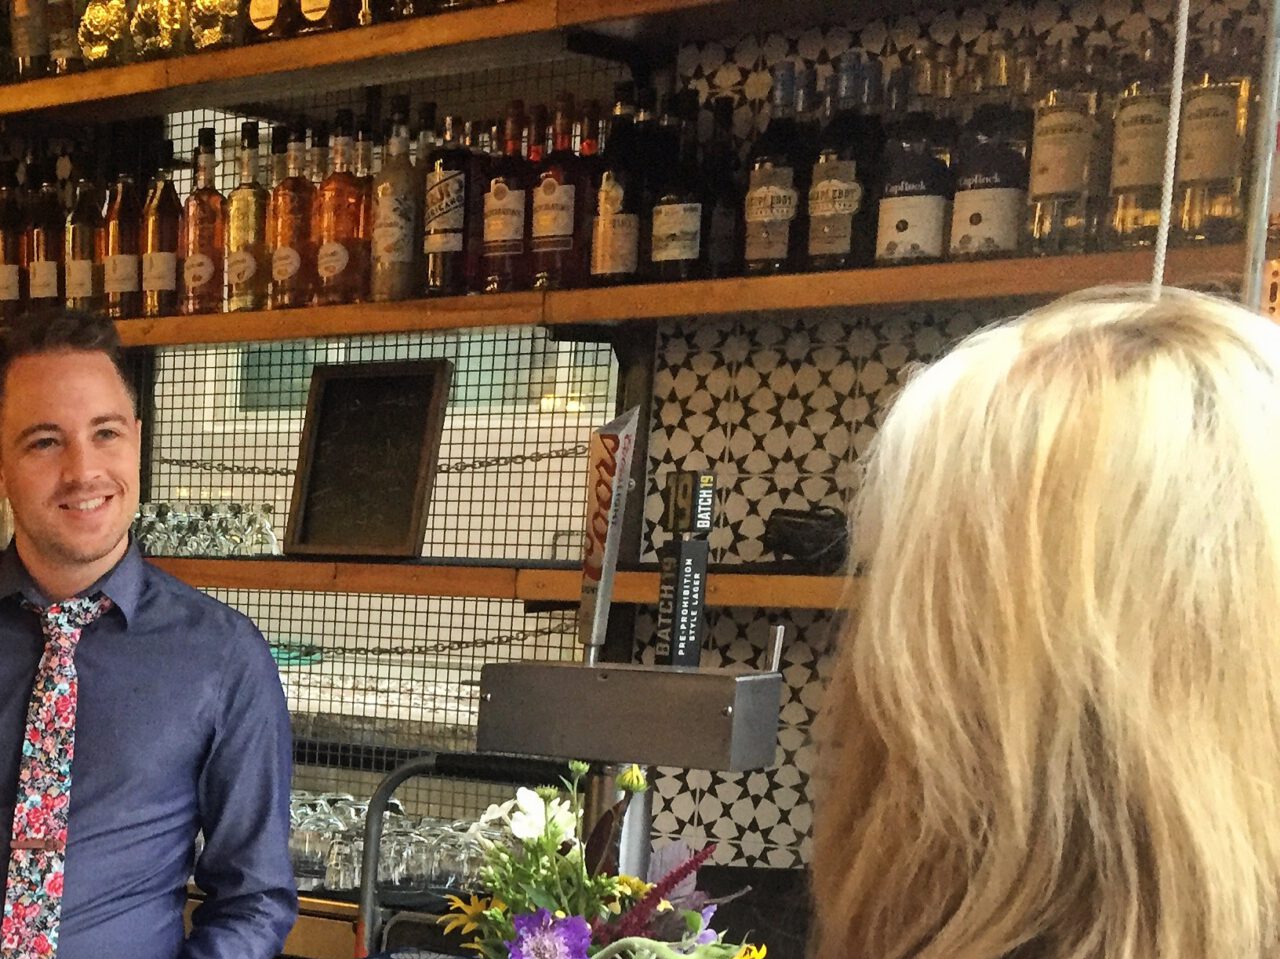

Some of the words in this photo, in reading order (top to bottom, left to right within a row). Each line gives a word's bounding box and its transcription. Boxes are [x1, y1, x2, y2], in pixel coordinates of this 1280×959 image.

[700, 475, 714, 488] 19
[582, 433, 620, 581] Coors
[697, 490, 713, 528] BATCH
[678, 558, 693, 656] PRE-PROHIBITION
[692, 573, 701, 605] LAGER
[655, 584, 675, 656] BATCH
[689, 610, 698, 641] STYLE
